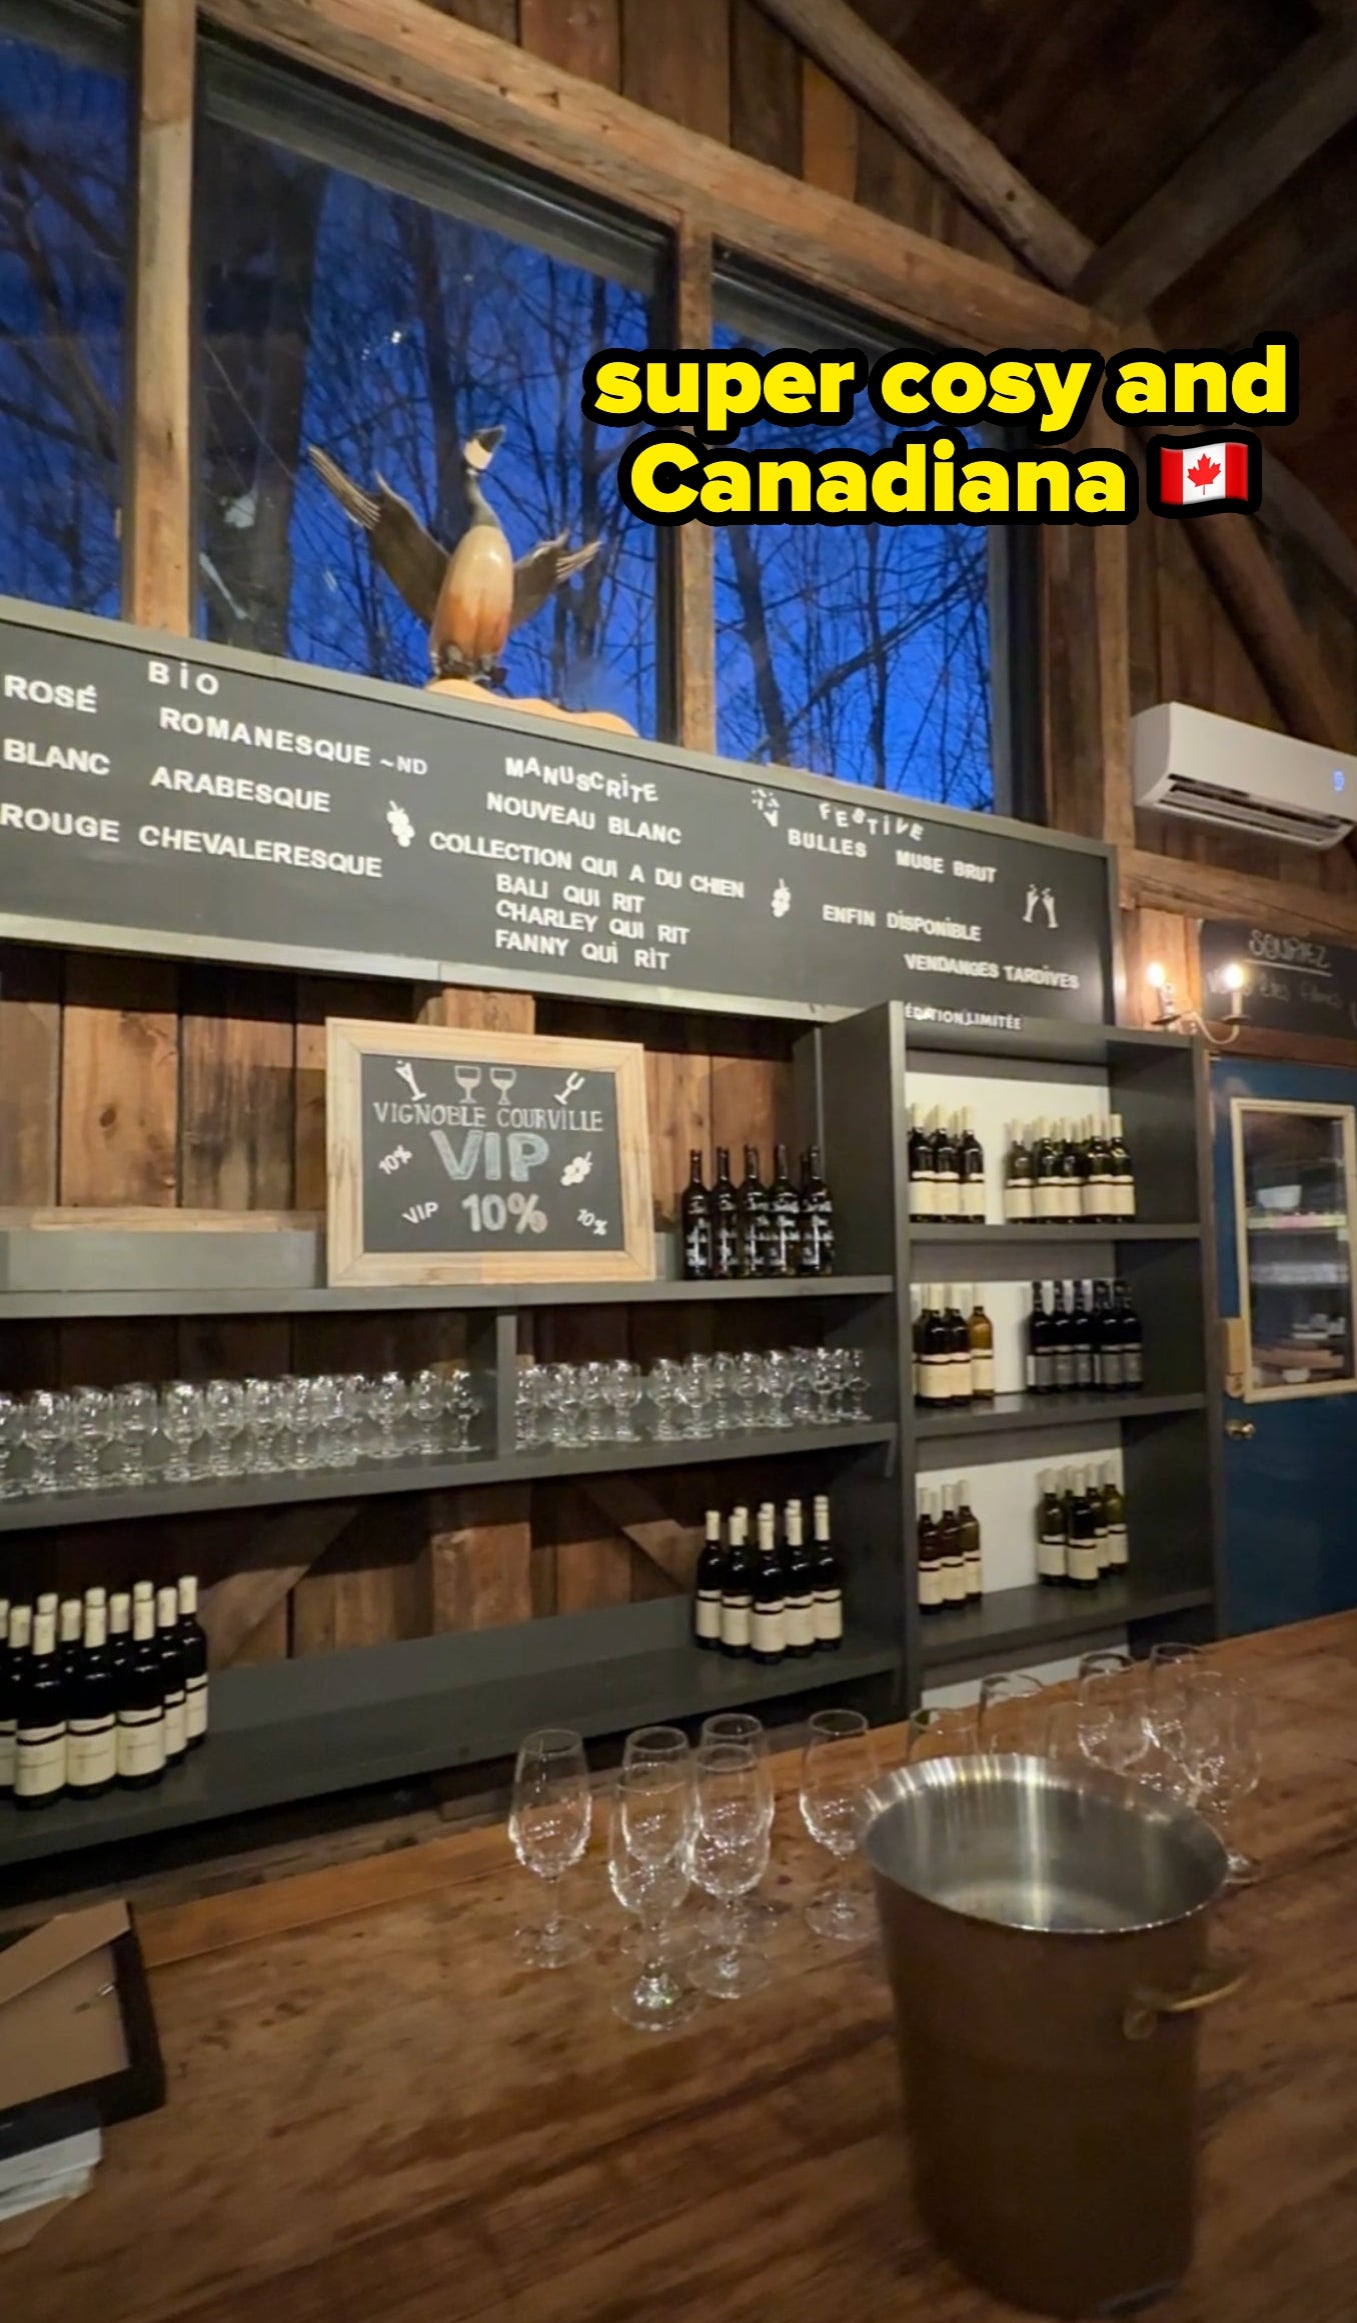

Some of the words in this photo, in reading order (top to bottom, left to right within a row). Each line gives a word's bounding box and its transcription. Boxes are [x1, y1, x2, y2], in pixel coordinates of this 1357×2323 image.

[3, 674, 97, 713] ROSÉ
[159, 706, 371, 767] ROMANESQUE
[3, 738, 110, 776] BLANC
[150, 766, 331, 813] ARABESQUE
[0, 804, 120, 843] ROUGE
[486, 792, 596, 830] NOUVEAU
[608, 815, 682, 845] BLANC
[138, 825, 382, 878] CHEVALERESQUE
[429, 831, 572, 871] COLLECTION
[580, 855, 618, 878] QUI
[629, 865, 645, 883] A
[655, 868, 682, 889] DU
[690, 874, 744, 899] CHIEN
[787, 828, 867, 858] BULLES
[896, 849, 944, 874] MUSE
[952, 860, 997, 883] BRUT
[496, 873, 548, 900] BALI
[563, 886, 600, 908] QUI
[612, 892, 645, 914] RIT
[495, 900, 598, 933] CHARLEY
[608, 918, 644, 940] QUI
[657, 925, 690, 945] RIT
[822, 904, 876, 927] ENFIN
[495, 929, 569, 957] FANNY
[903, 953, 999, 979] VENDANGES
[373, 1102, 486, 1127] VIGNOBLE
[496, 1106, 604, 1132] COURVILLE
[377, 1144, 413, 1175] 10%
[429, 1129, 549, 1182] VIP
[401, 1201, 439, 1225] VIP
[461, 1191, 548, 1234] 10%
[576, 1208, 608, 1235] 10%
